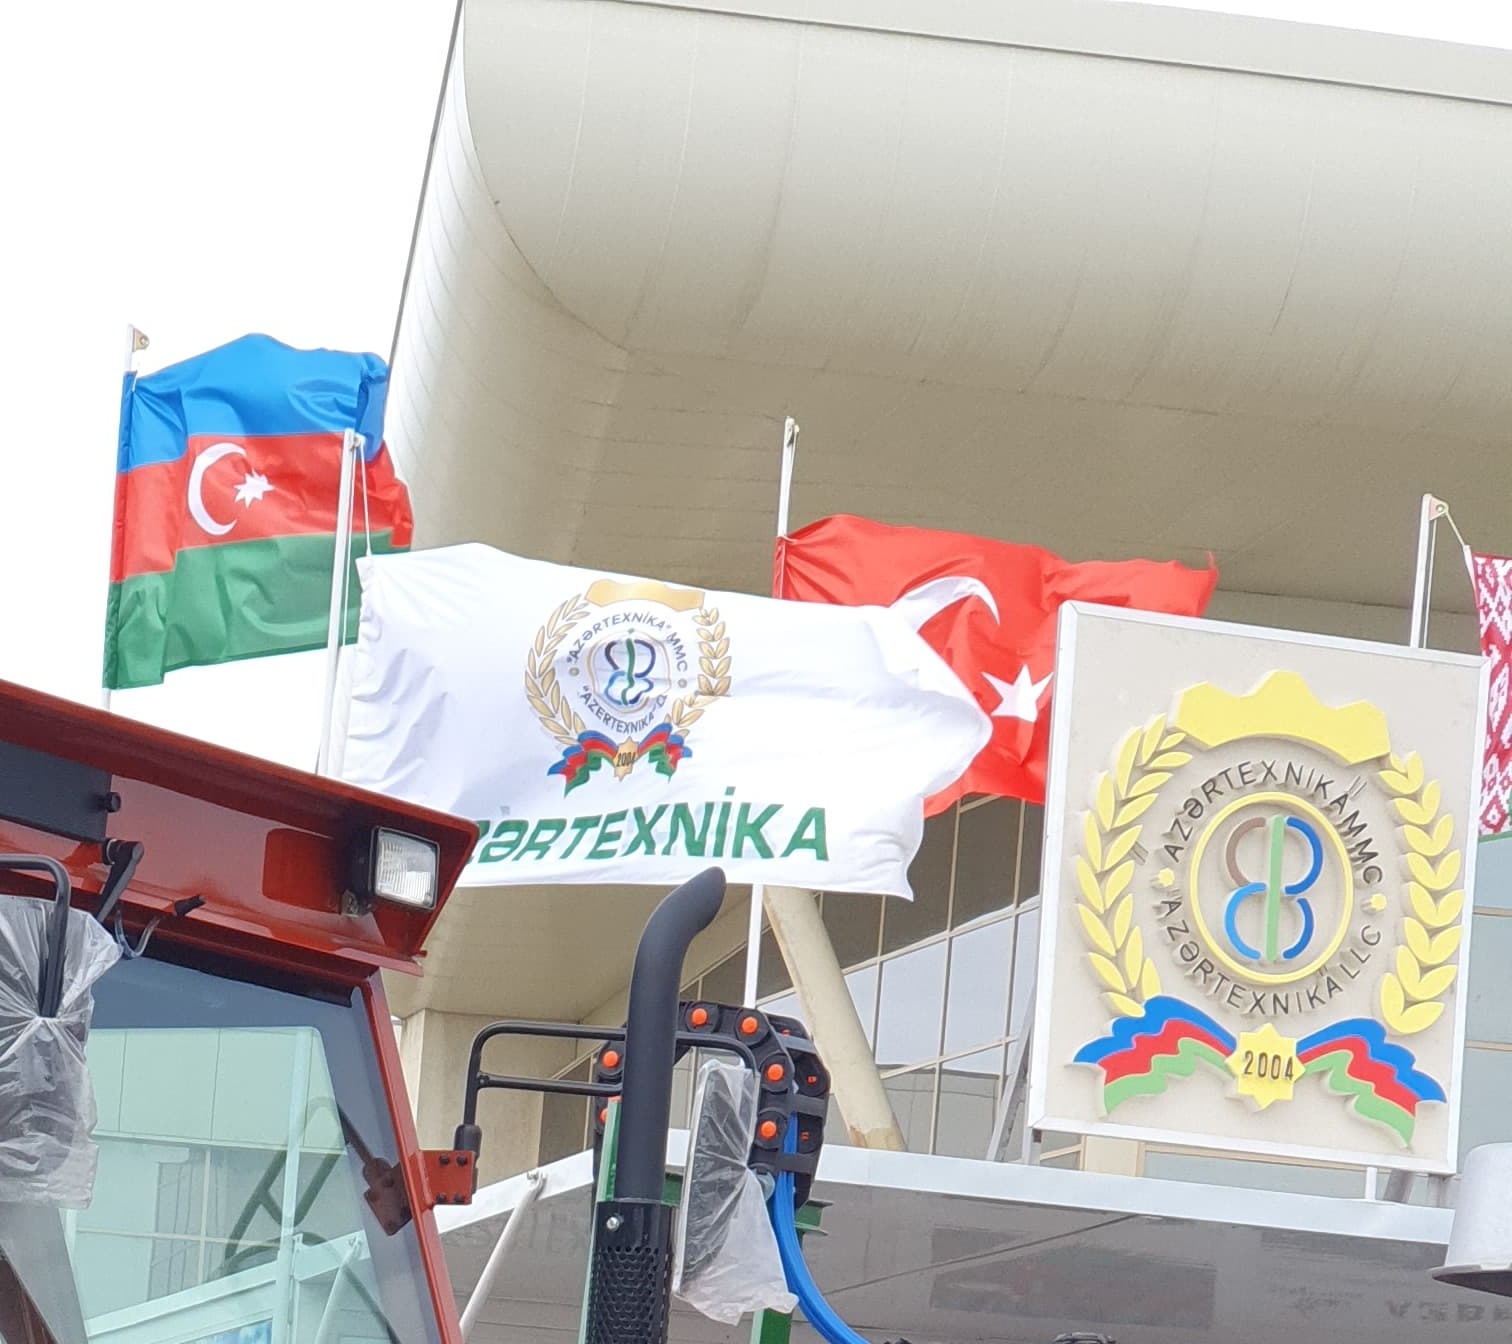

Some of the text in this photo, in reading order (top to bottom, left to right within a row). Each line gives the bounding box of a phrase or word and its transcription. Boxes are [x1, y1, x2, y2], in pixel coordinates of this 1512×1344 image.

[666, 632, 688, 673] MMC
[468, 786, 830, 864] ƏRTEXNİKA
[1341, 810, 1383, 885] MMC
[1340, 925, 1381, 980] LLC
[1243, 1051, 1295, 1081] 2004
